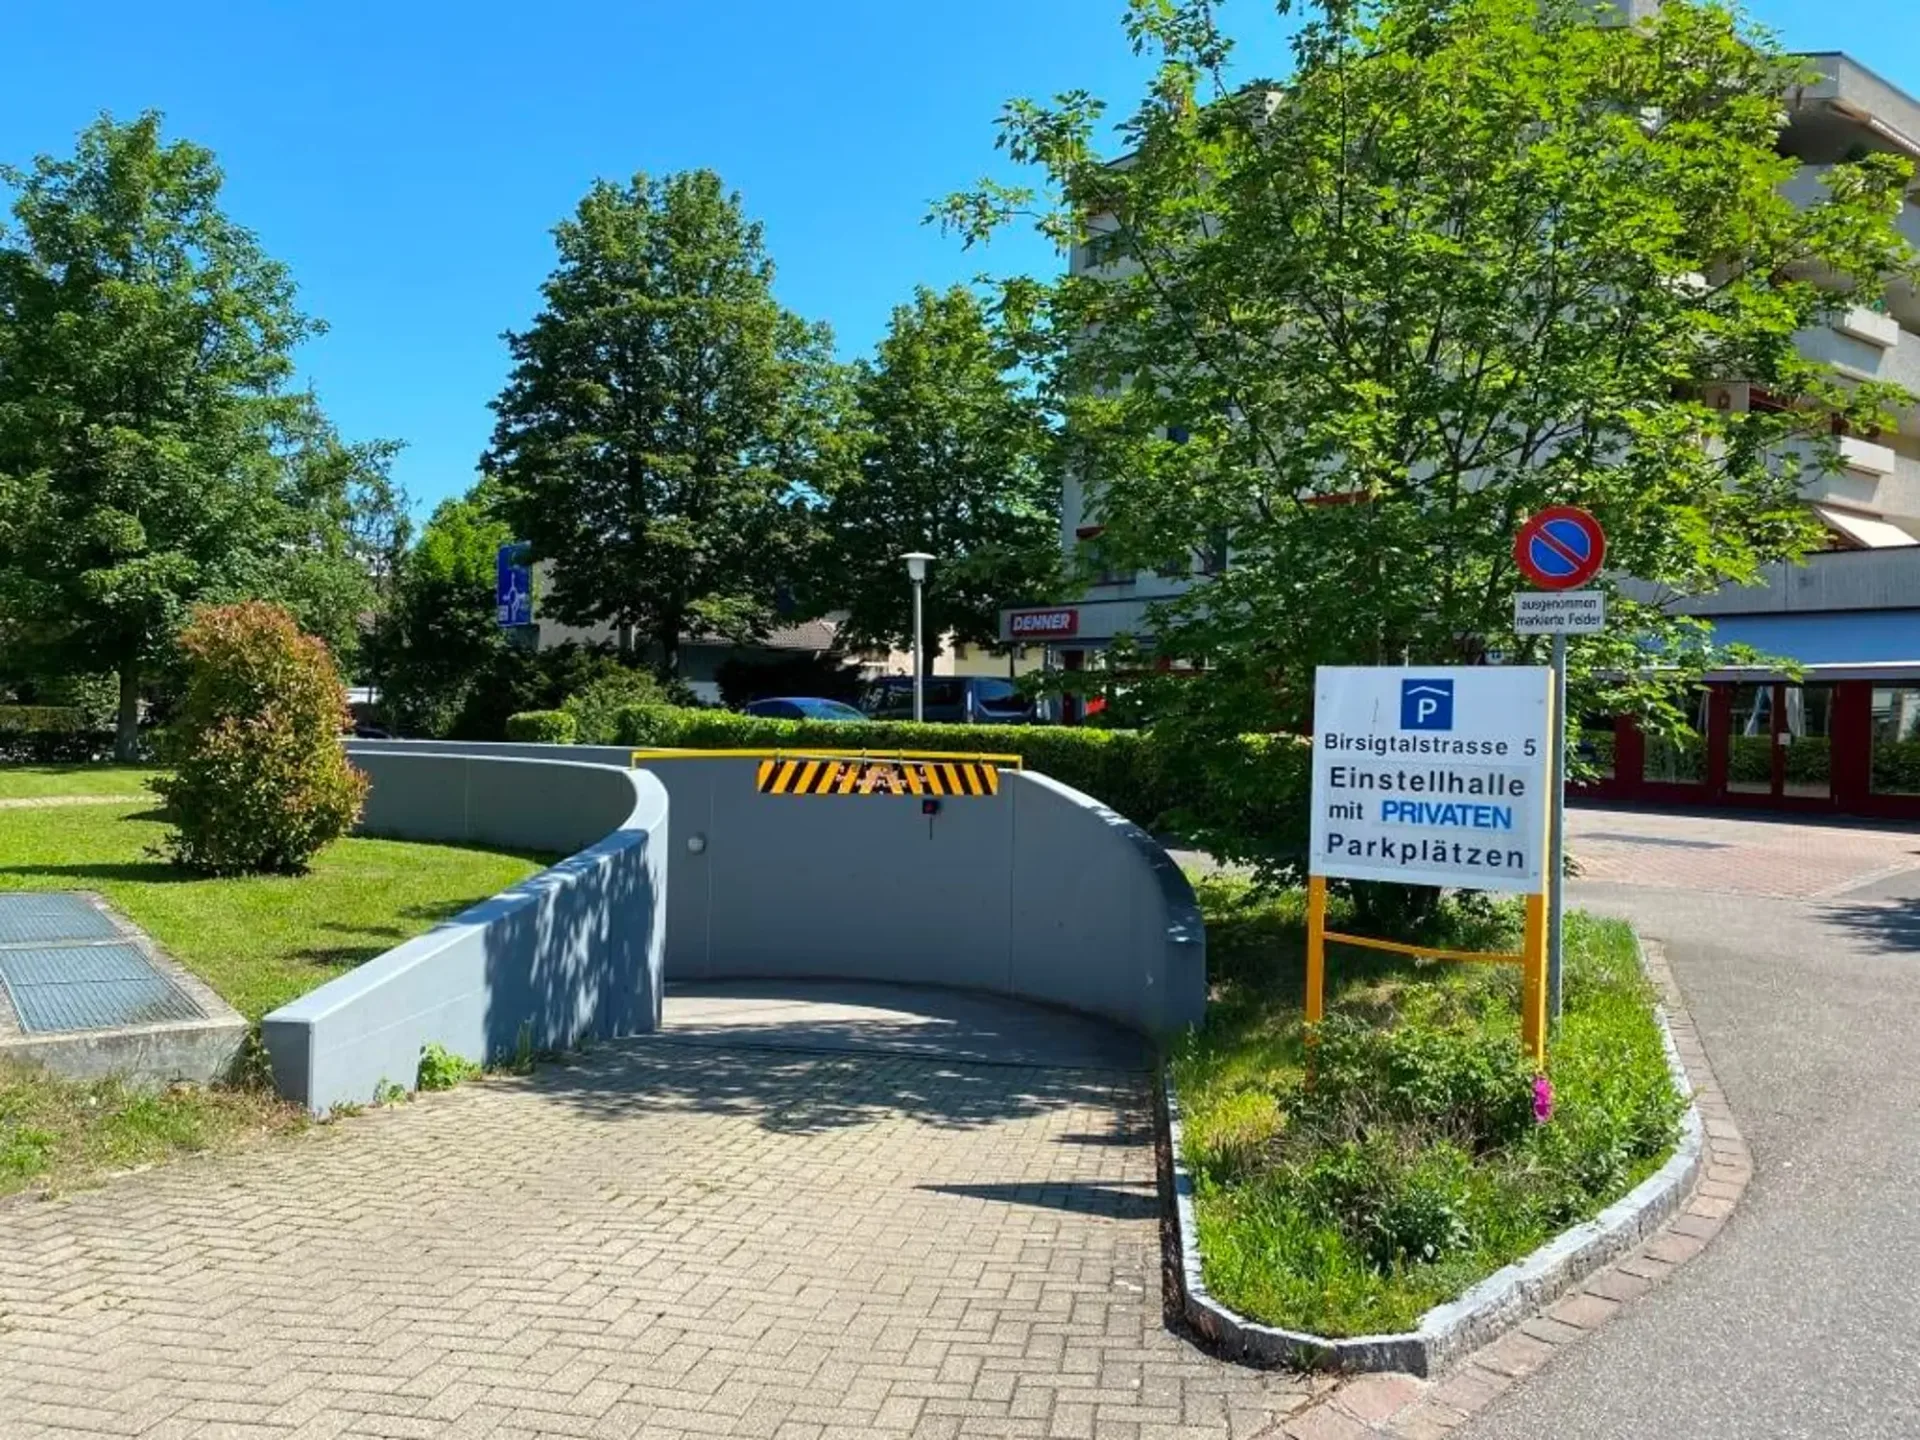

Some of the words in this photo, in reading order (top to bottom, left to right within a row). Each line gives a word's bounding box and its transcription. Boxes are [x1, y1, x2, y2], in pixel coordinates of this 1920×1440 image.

[1521, 599, 1597, 612] ausgenommen
[1013, 612, 1070, 631] DENNER
[1516, 614, 1565, 627] markierte
[1568, 612, 1601, 625] Felder
[1417, 698, 1437, 723] P
[1324, 732, 1509, 757] Birsigtalstrasse
[1523, 738, 1537, 757] 5
[1330, 766, 1525, 797] Einstellhalle
[1328, 802, 1364, 821] mit
[1380, 800, 1513, 830] PRIVATEN
[1327, 833, 1525, 869] Parkplätzen
